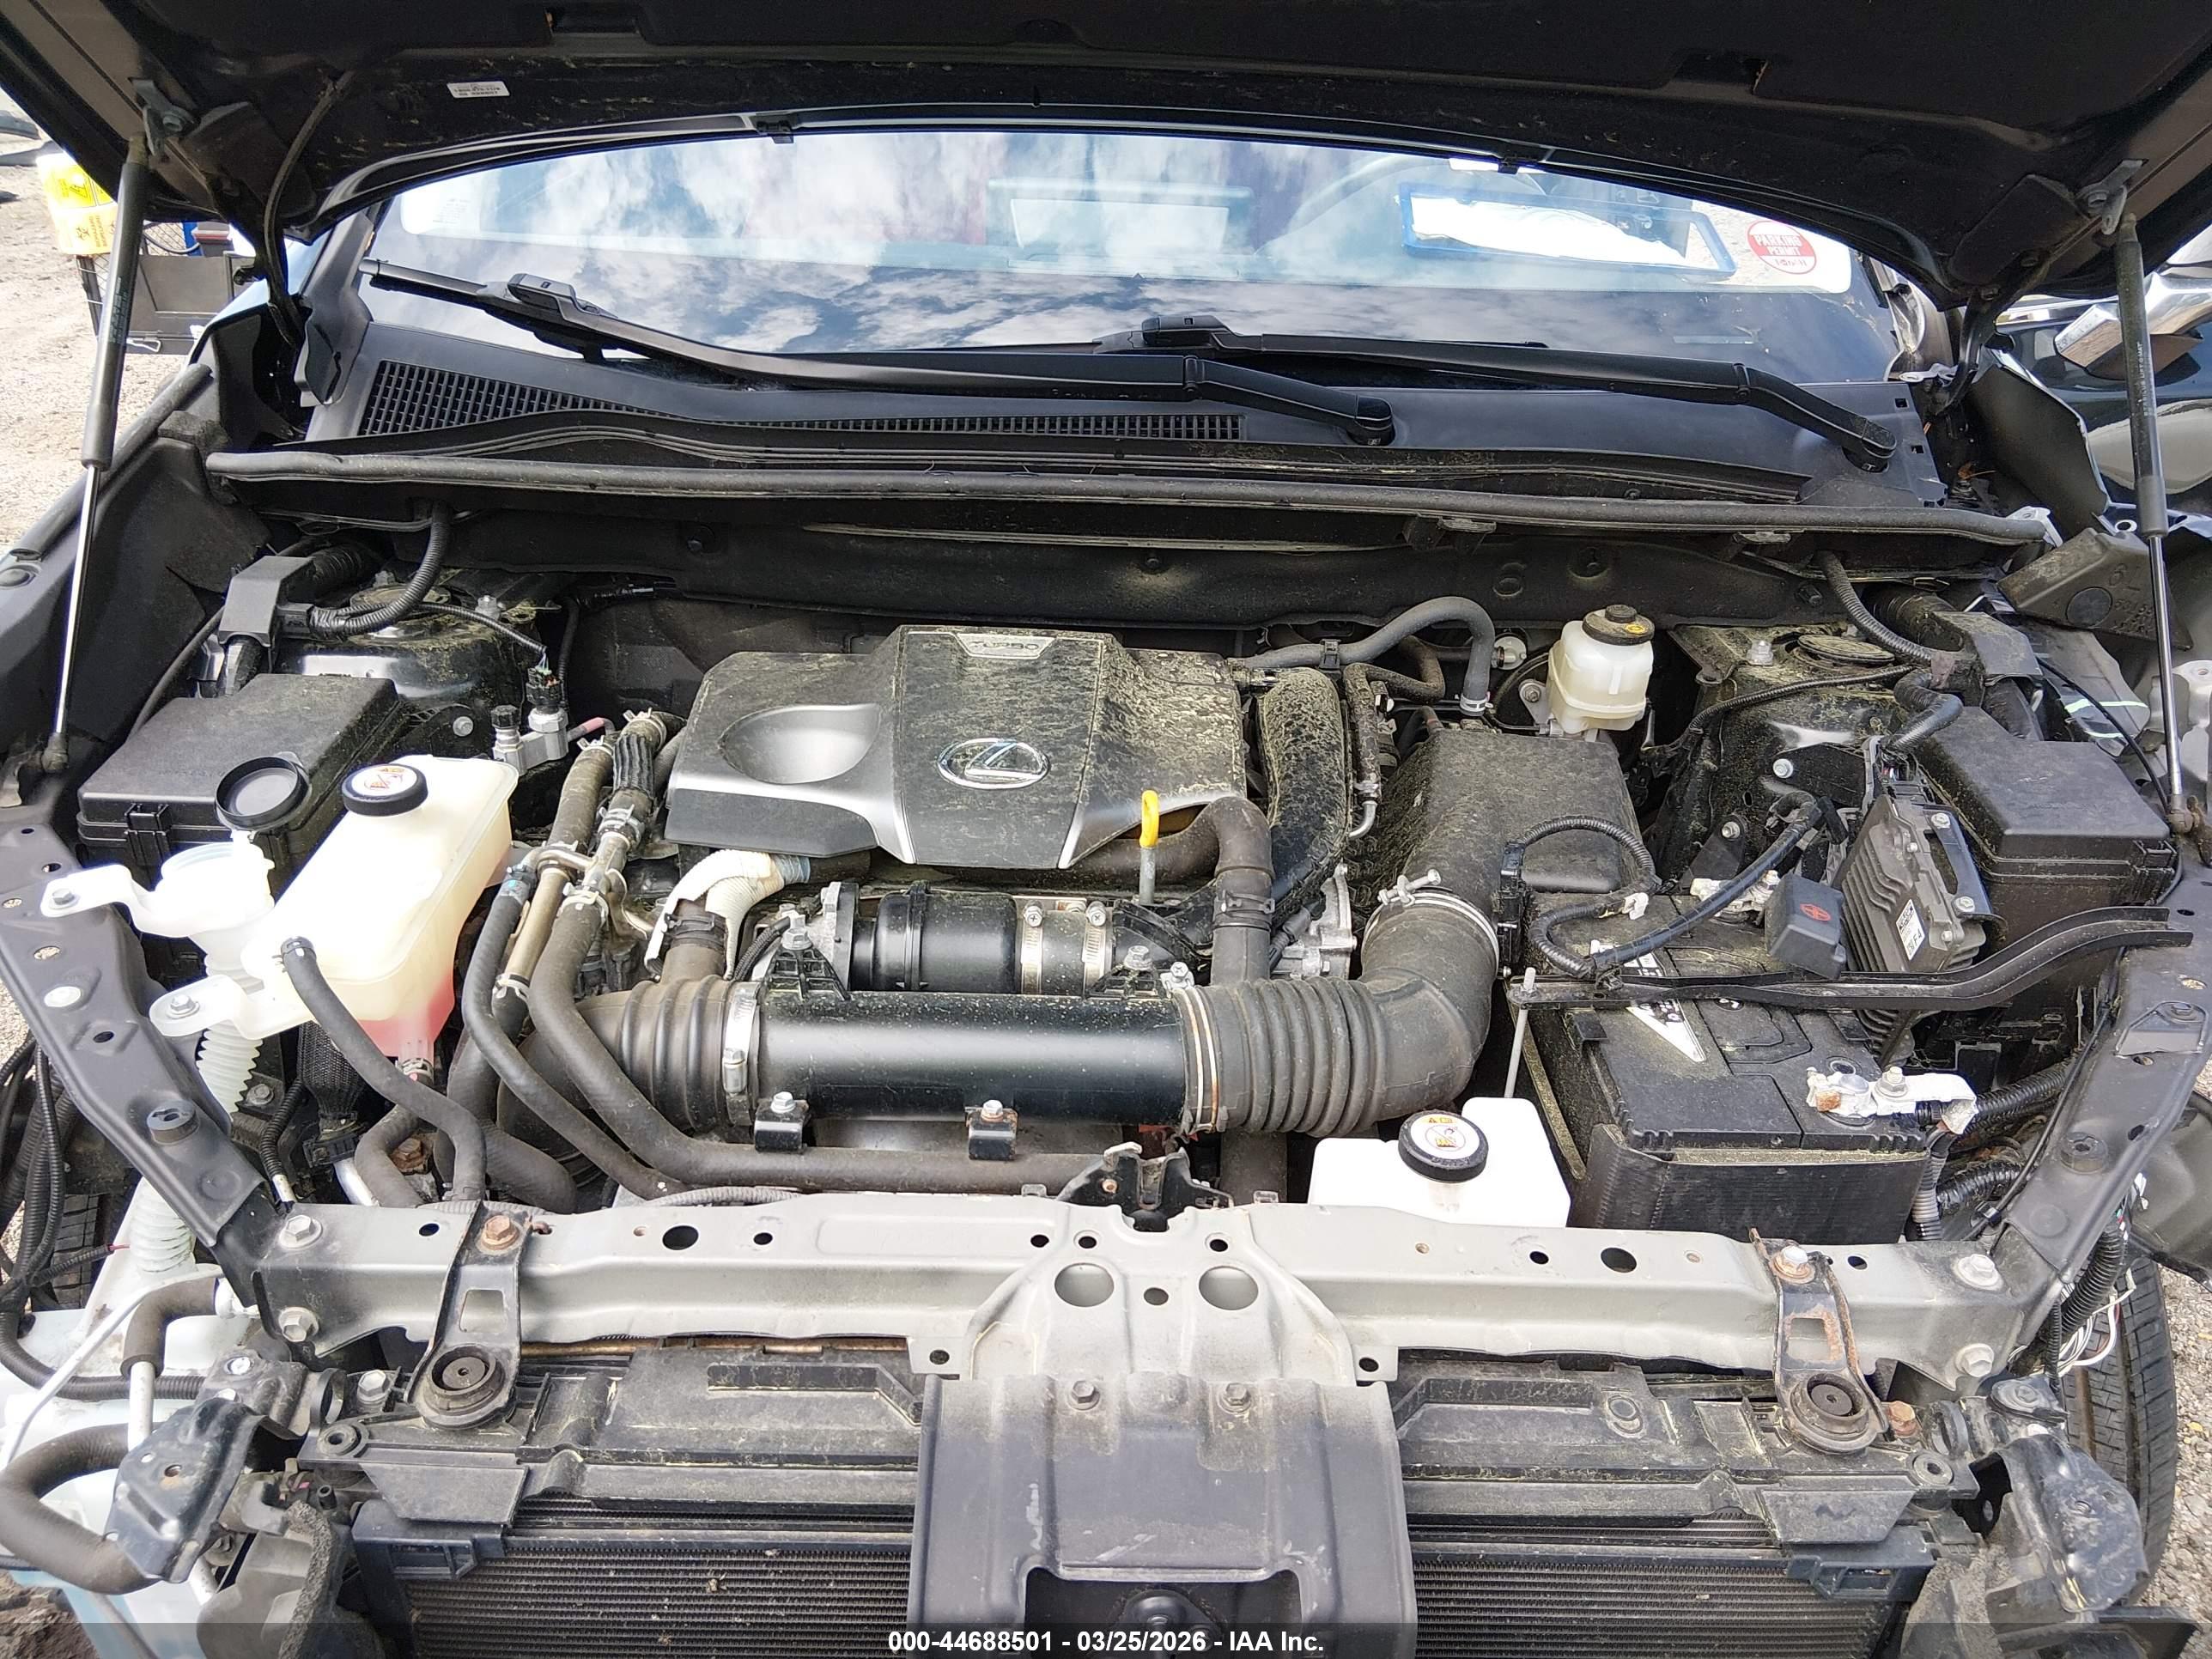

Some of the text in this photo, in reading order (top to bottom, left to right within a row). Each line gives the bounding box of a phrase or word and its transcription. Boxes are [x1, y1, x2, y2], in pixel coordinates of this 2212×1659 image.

[1753, 234, 1802, 246] PARKING
[1767, 246, 1801, 255] PERMIT
[969, 641, 1039, 650] TURBO
